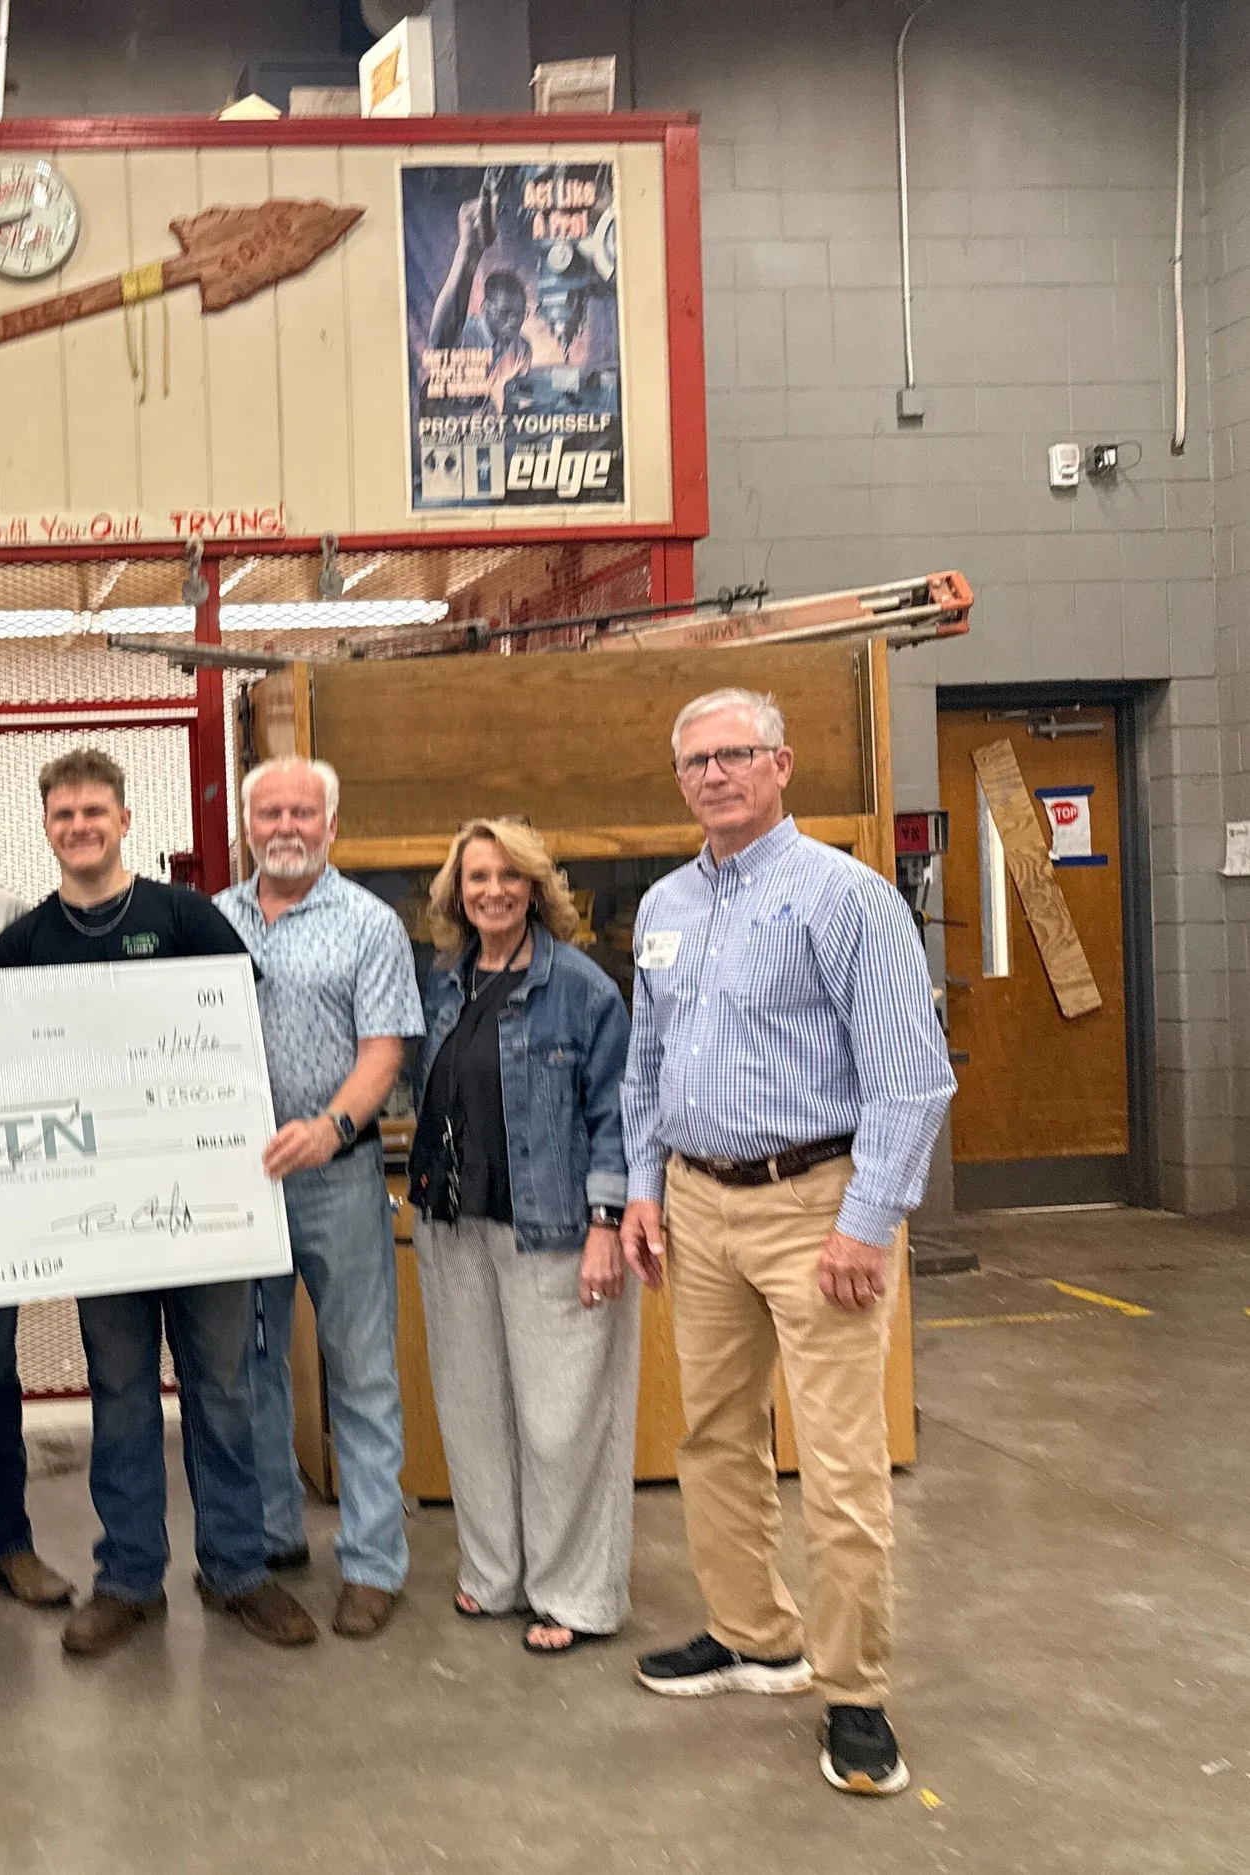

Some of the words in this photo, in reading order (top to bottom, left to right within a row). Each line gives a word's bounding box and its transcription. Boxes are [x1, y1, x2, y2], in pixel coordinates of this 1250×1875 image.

[419, 415, 507, 436] PROTECT
[512, 412, 611, 434] YOURSELF
[507, 435, 611, 498] edge
[39, 513, 80, 543] You
[170, 500, 286, 537] TRYING!
[198, 988, 224, 1008] 001
